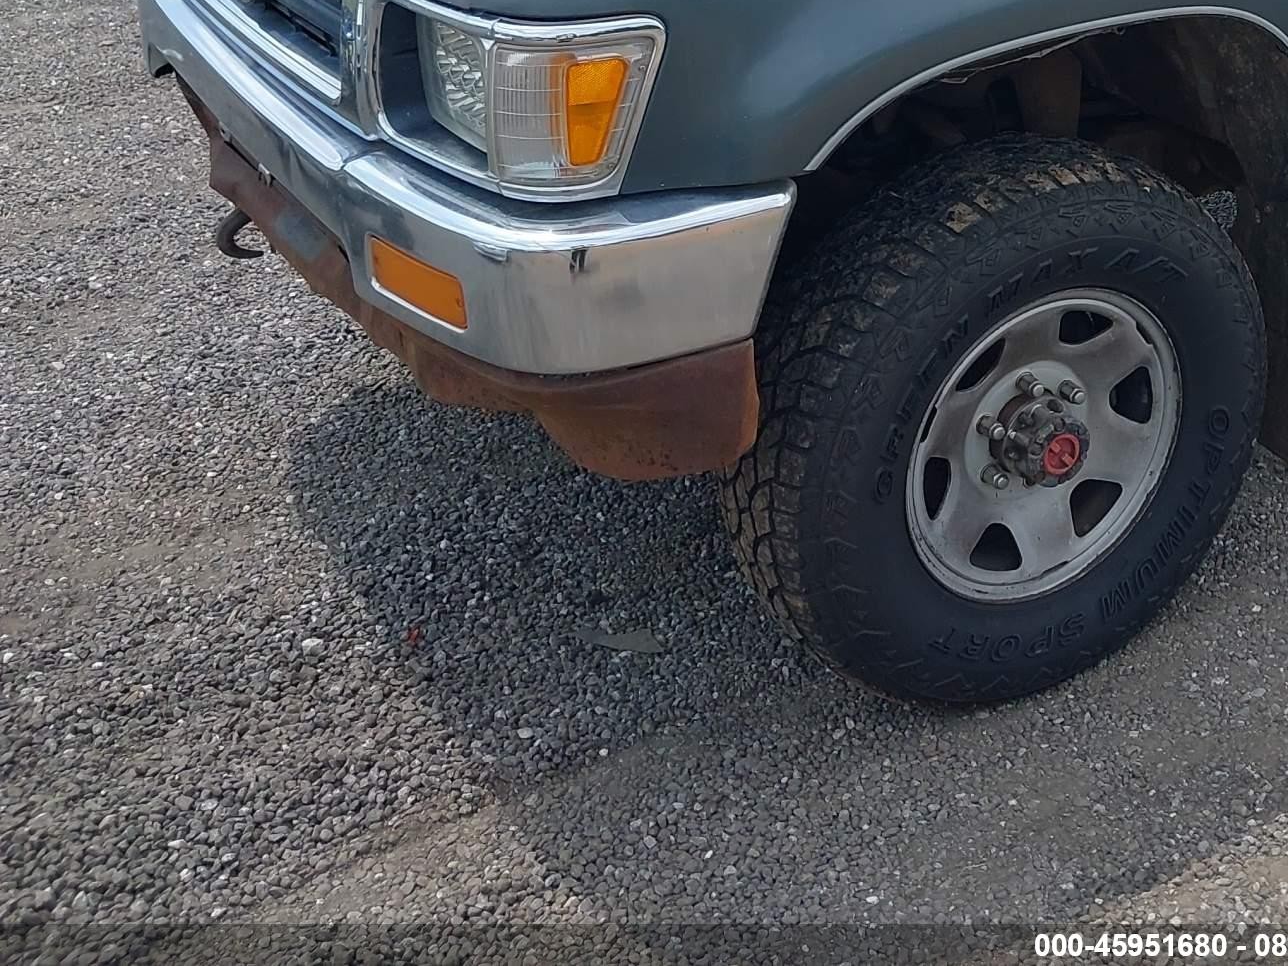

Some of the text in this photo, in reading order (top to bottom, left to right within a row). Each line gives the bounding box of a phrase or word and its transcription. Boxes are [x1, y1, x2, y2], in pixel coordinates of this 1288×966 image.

[987, 246, 1099, 310] MAX
[1103, 246, 1189, 284] A/T
[927, 405, 1232, 662] OPTIMUM SPORT
